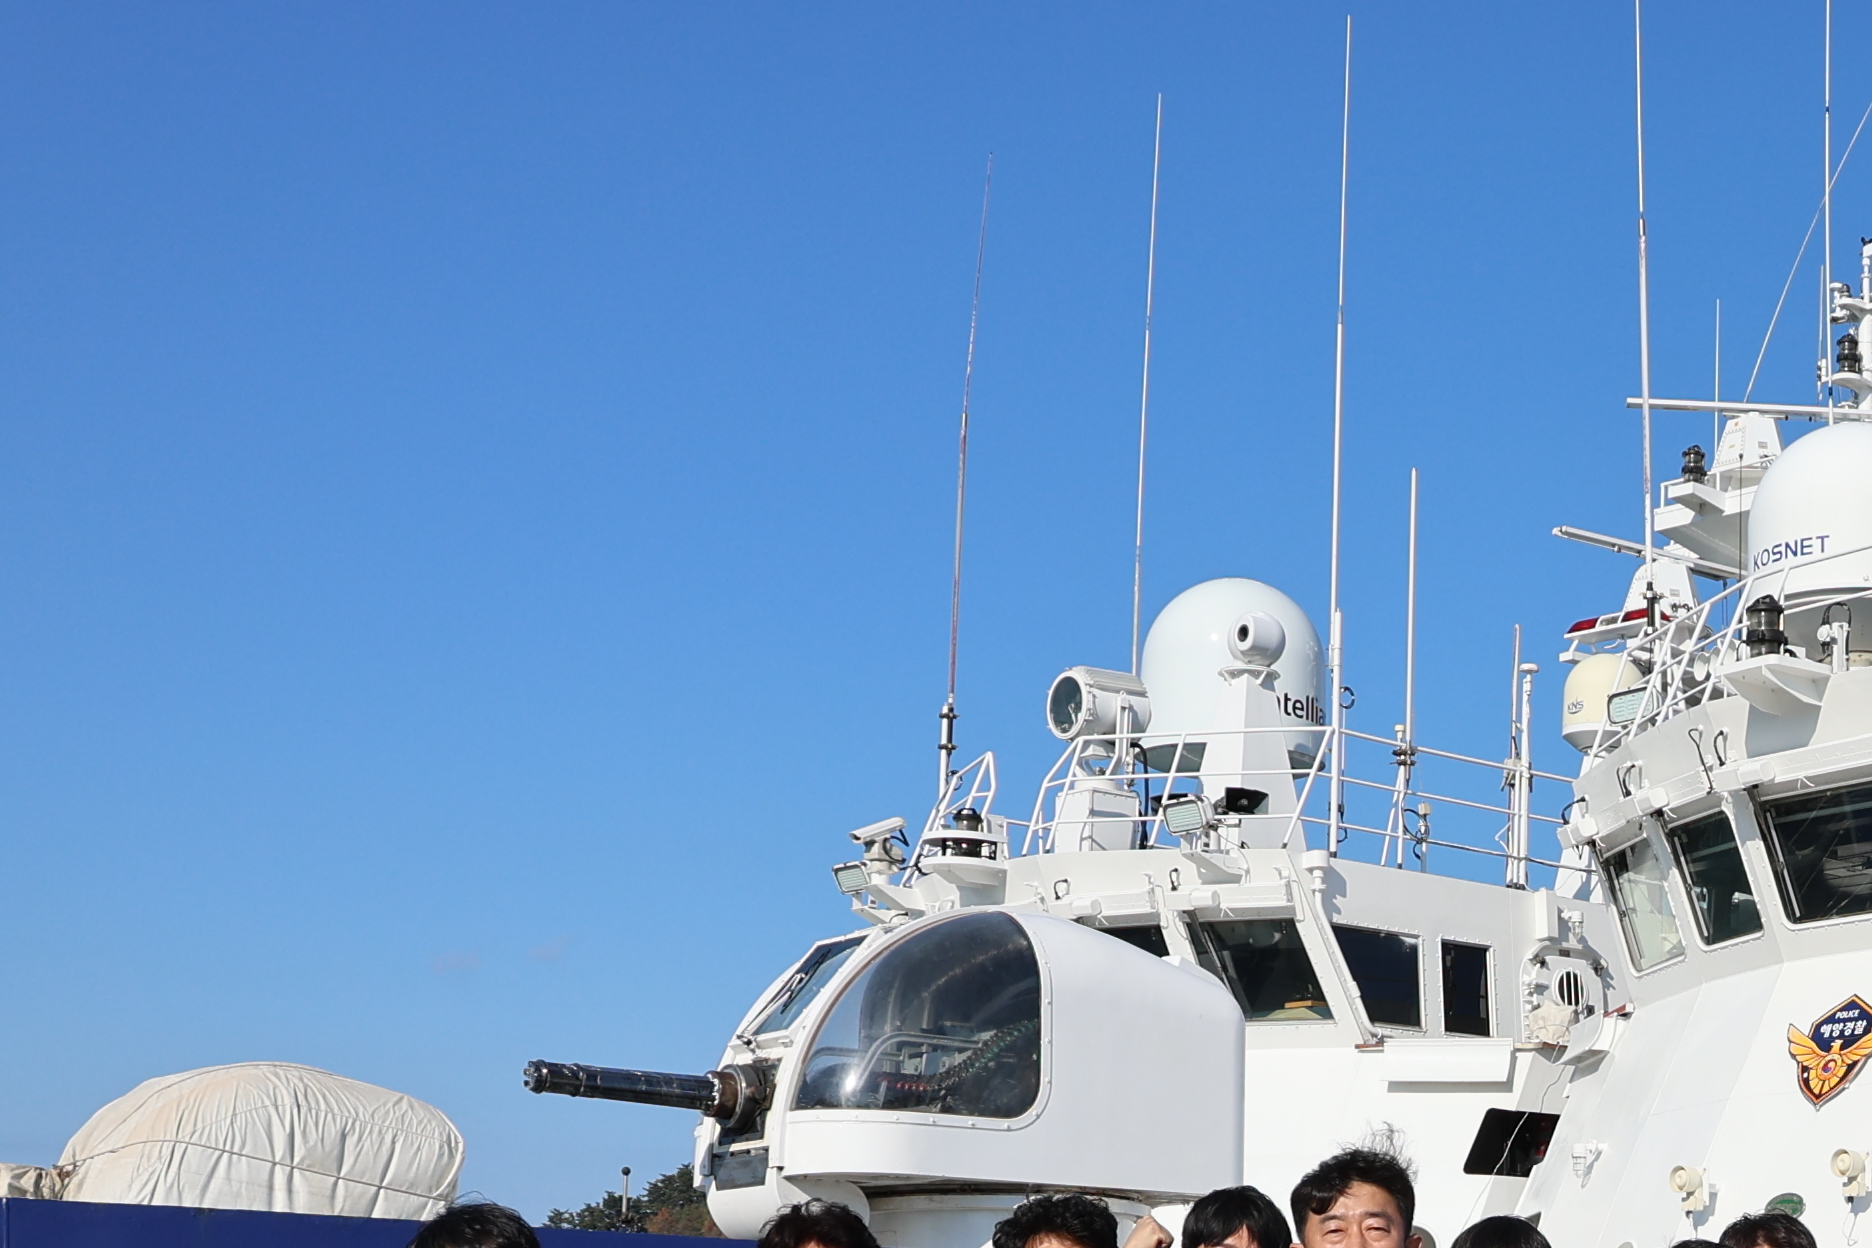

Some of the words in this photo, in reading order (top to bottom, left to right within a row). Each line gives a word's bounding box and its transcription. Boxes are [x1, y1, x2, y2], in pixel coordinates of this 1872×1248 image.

[1753, 534, 1830, 573] KOSNET
[1835, 1009, 1861, 1020] POLICE
[1820, 1019, 1868, 1038] 해양경찰
